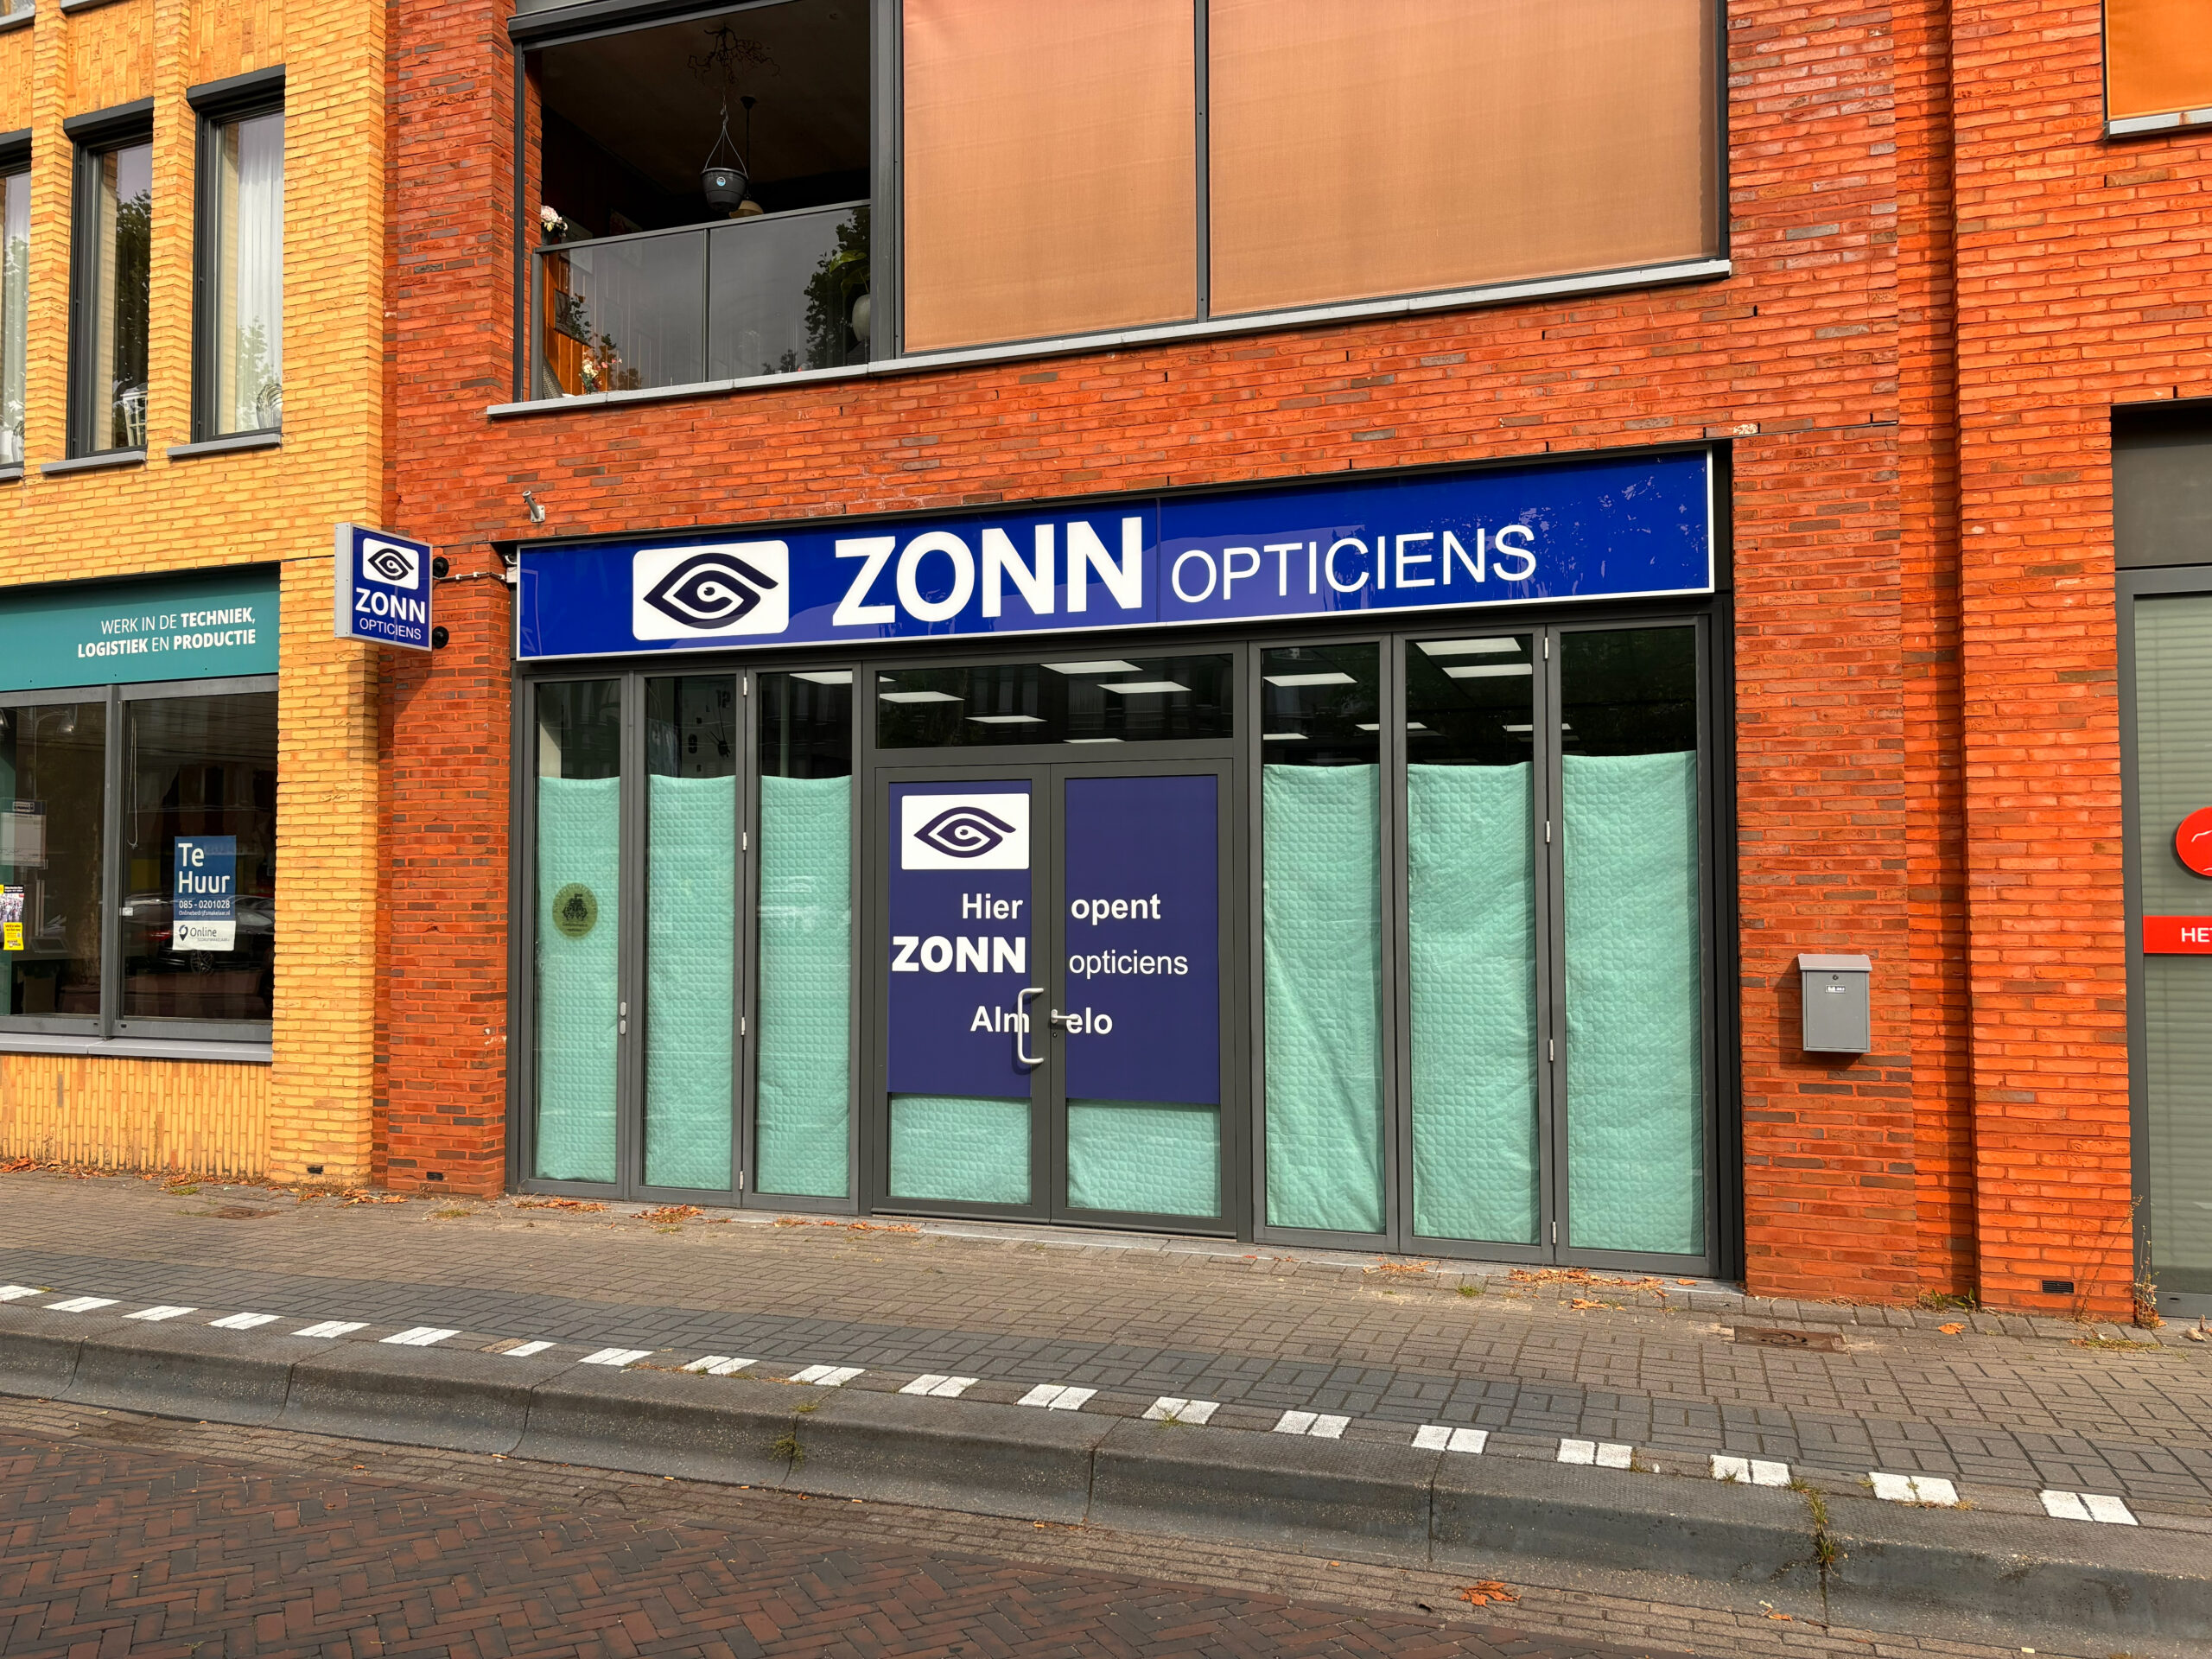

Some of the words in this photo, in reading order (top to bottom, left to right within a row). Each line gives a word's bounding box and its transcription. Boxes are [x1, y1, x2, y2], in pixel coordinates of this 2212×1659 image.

[832, 516, 1142, 626] ZONN
[1172, 524, 1537, 603] OPTICIENS
[355, 587, 426, 624] ZONN
[101, 617, 138, 634] WERK
[142, 616, 156, 632] IN
[159, 614, 177, 630] DE
[181, 607, 256, 628] TECHNIEK,
[359, 617, 422, 640] OPTICIENS
[78, 638, 149, 658] LOGISTIEK
[152, 636, 169, 652] EN
[174, 629, 256, 651] PRODUCTIE
[178, 842, 205, 867] Te
[178, 870, 231, 893] Huur
[179, 899, 193, 909] 085
[199, 899, 231, 909] 0201028
[962, 893, 1023, 919] Hier
[1071, 893, 1160, 925] opent
[190, 926, 218, 938] Online
[2181, 927, 2212, 943] HE
[891, 936, 1026, 974] ZONN
[1069, 949, 1189, 980] opticiens
